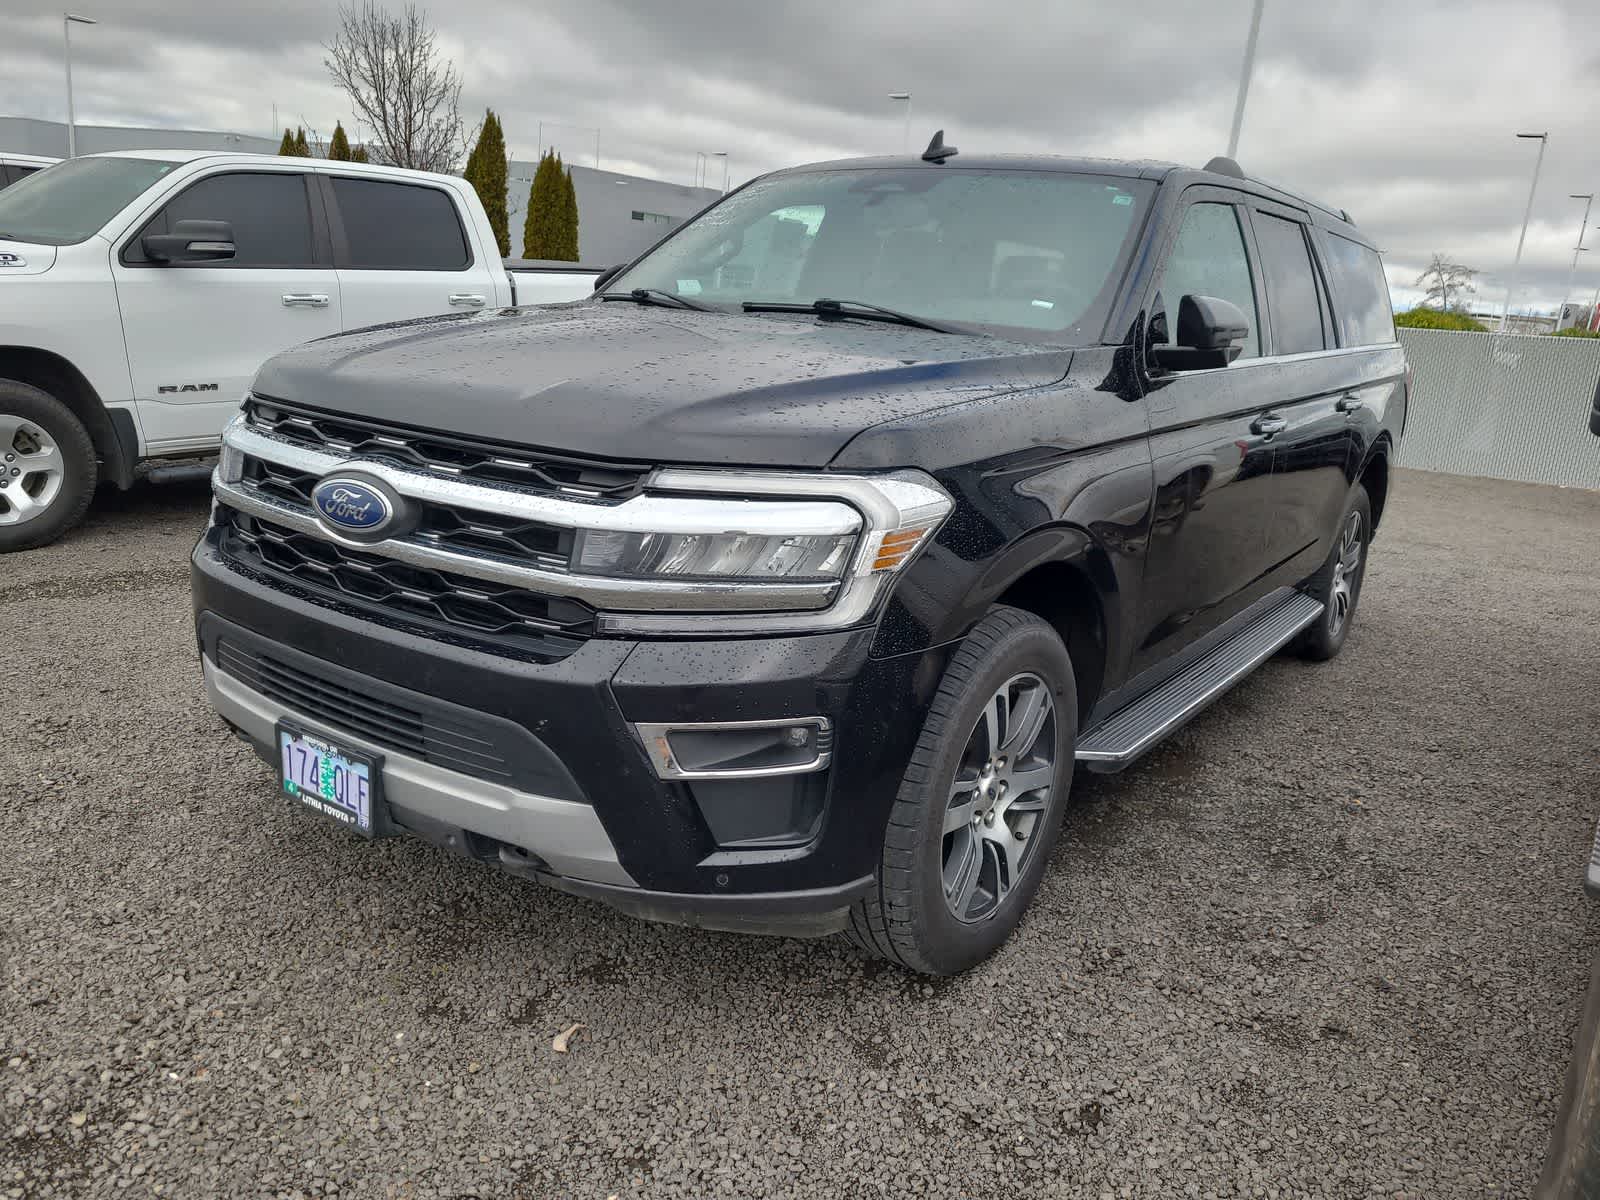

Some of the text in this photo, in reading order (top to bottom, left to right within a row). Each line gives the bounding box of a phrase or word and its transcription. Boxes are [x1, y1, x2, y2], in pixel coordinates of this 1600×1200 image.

[158, 383, 218, 394] RAM
[325, 488, 371, 521] Ford
[286, 744, 369, 816] 174 QLF
[302, 794, 349, 823] LITHIA TOYOTA
